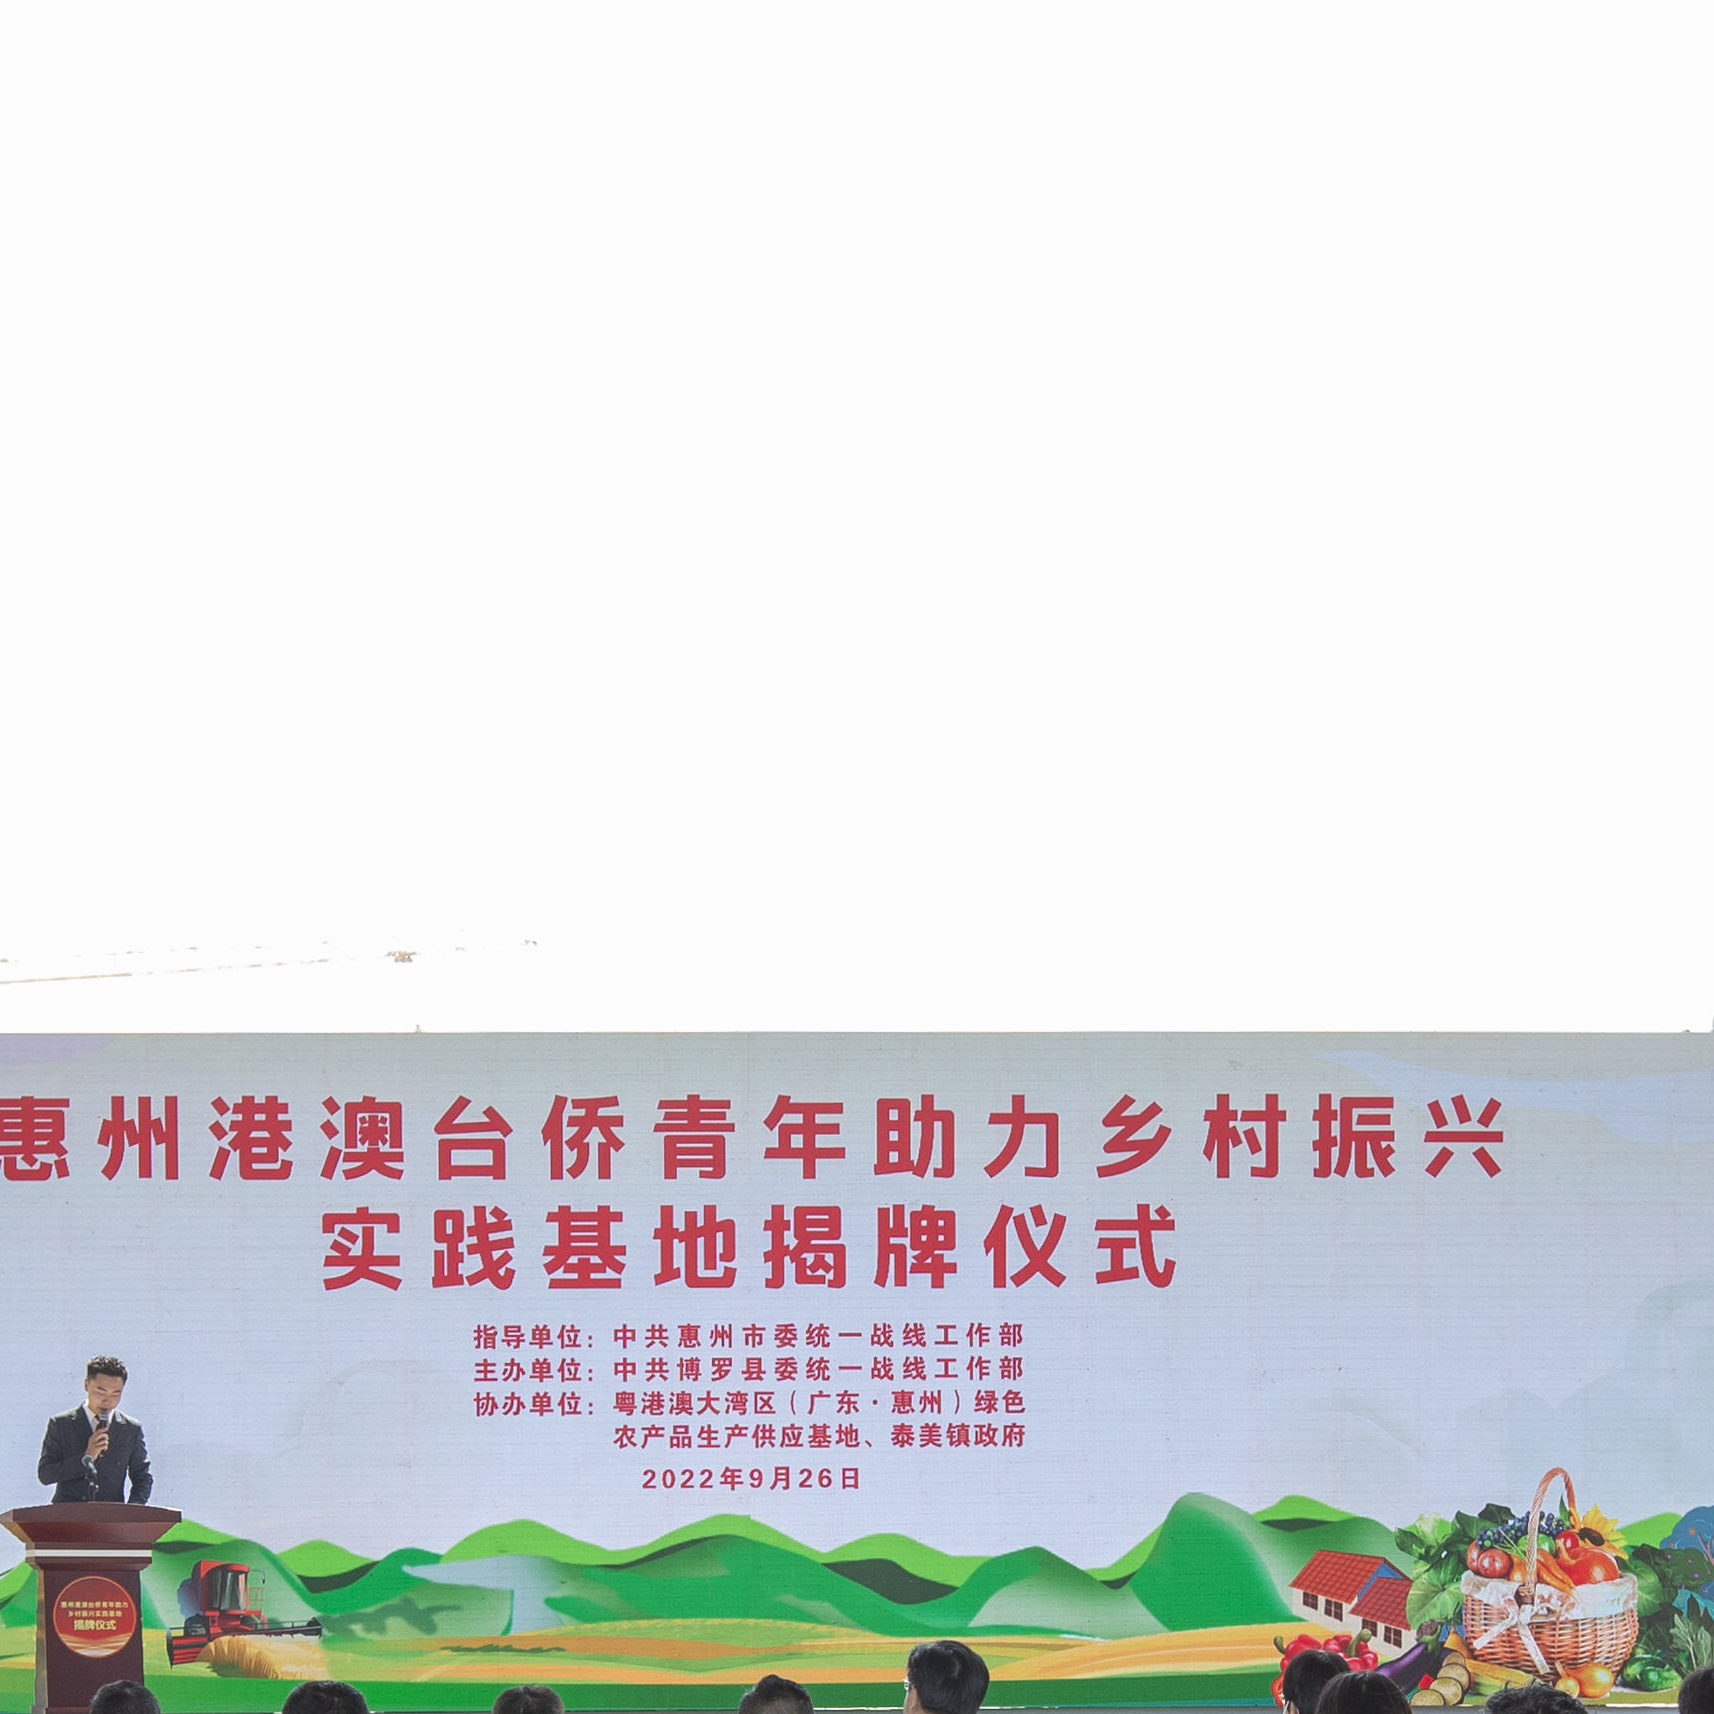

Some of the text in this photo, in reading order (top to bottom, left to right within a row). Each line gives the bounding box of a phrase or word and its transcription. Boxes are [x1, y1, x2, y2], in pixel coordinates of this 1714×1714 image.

[321, 1203, 1178, 1291] 实践基地揭牌仪式
[613, 1422, 1027, 1449] 农产品生产供应基地、泰美镇政府
[642, 1465, 861, 1491] 2022年9月26日
